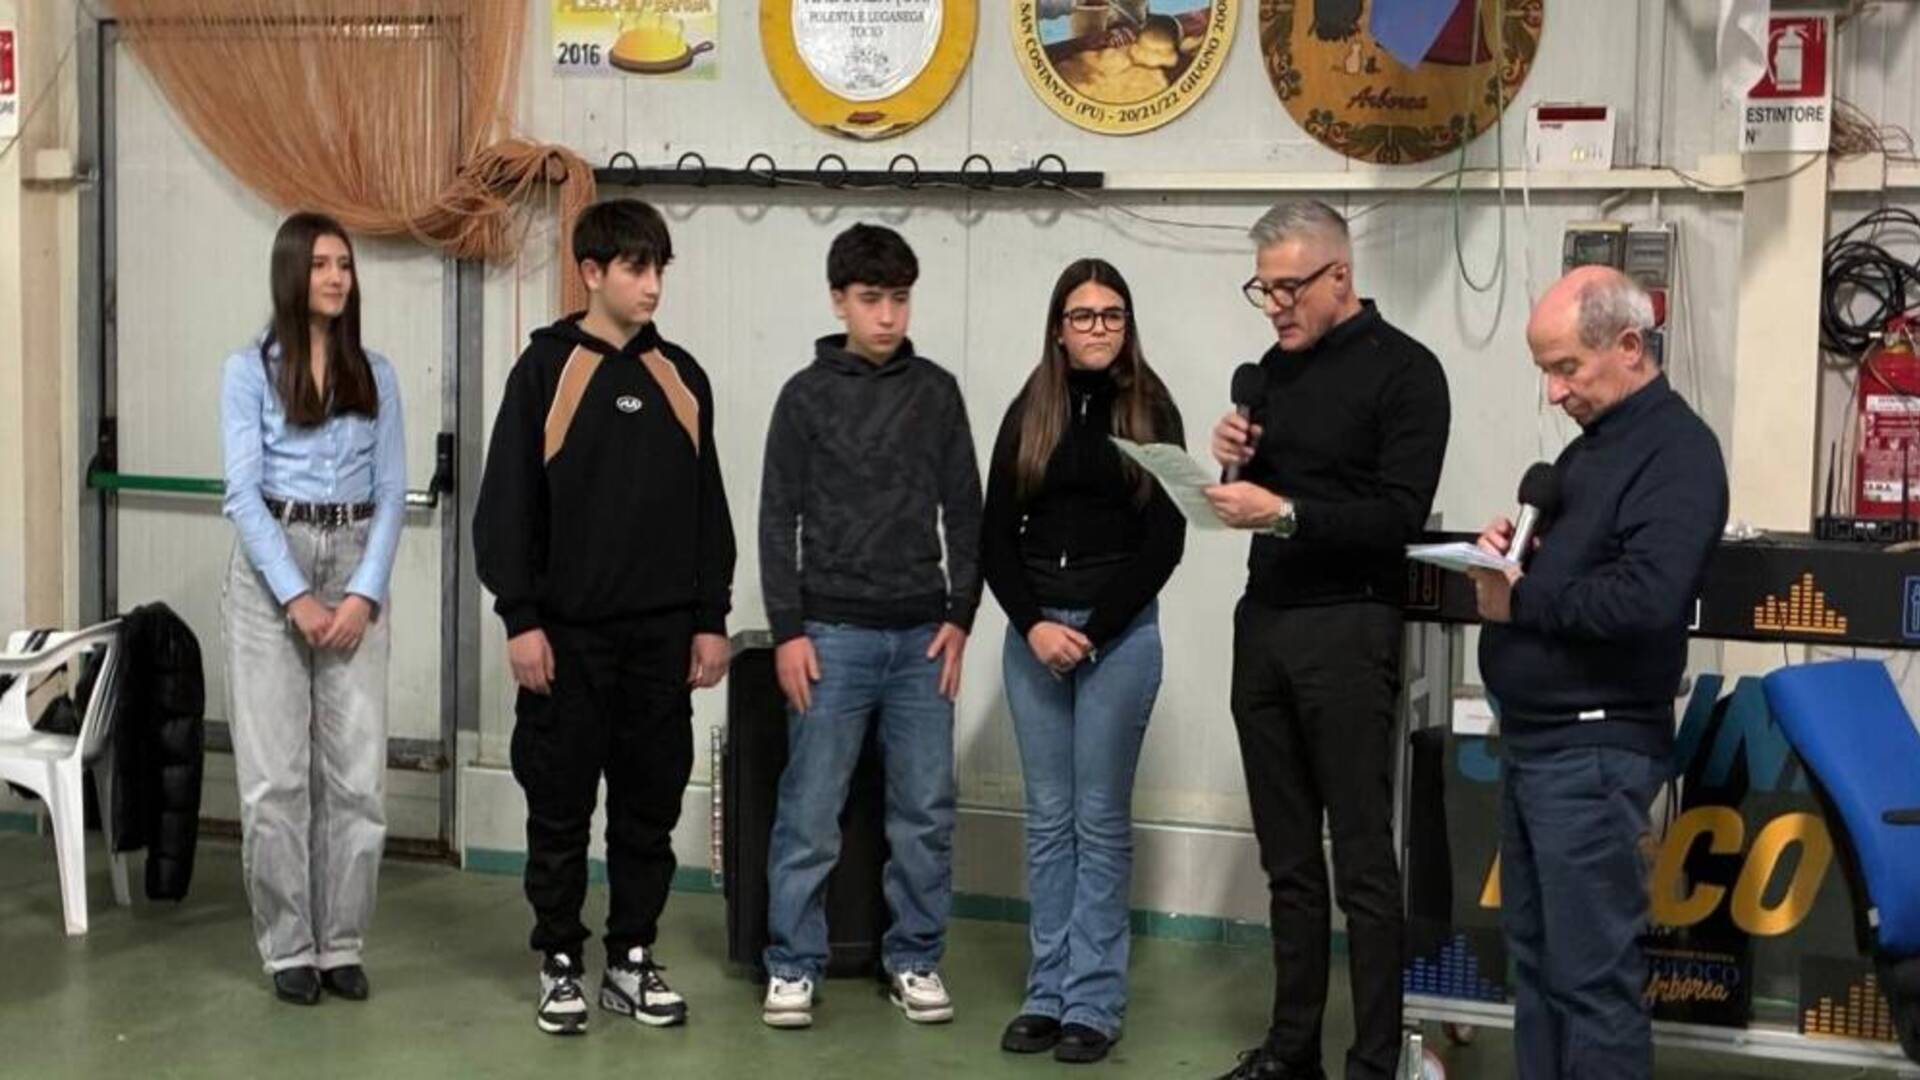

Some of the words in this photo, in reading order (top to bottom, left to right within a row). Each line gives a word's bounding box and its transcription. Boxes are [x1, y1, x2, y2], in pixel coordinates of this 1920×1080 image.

[809, 10, 854, 23] POLENTA
[858, 10, 865, 22] E
[868, 10, 924, 23] LUGANEGA
[1019, 2, 1034, 35] SAN
[558, 42, 601, 65] 2016
[1180, 39, 1221, 94] GIUGNO
[1025, 37, 1075, 107] COSTANZO
[1075, 101, 1106, 122] (PU)
[1118, 92, 1181, 122] 20/21/22
[1746, 105, 1825, 123] ESTINTORE
